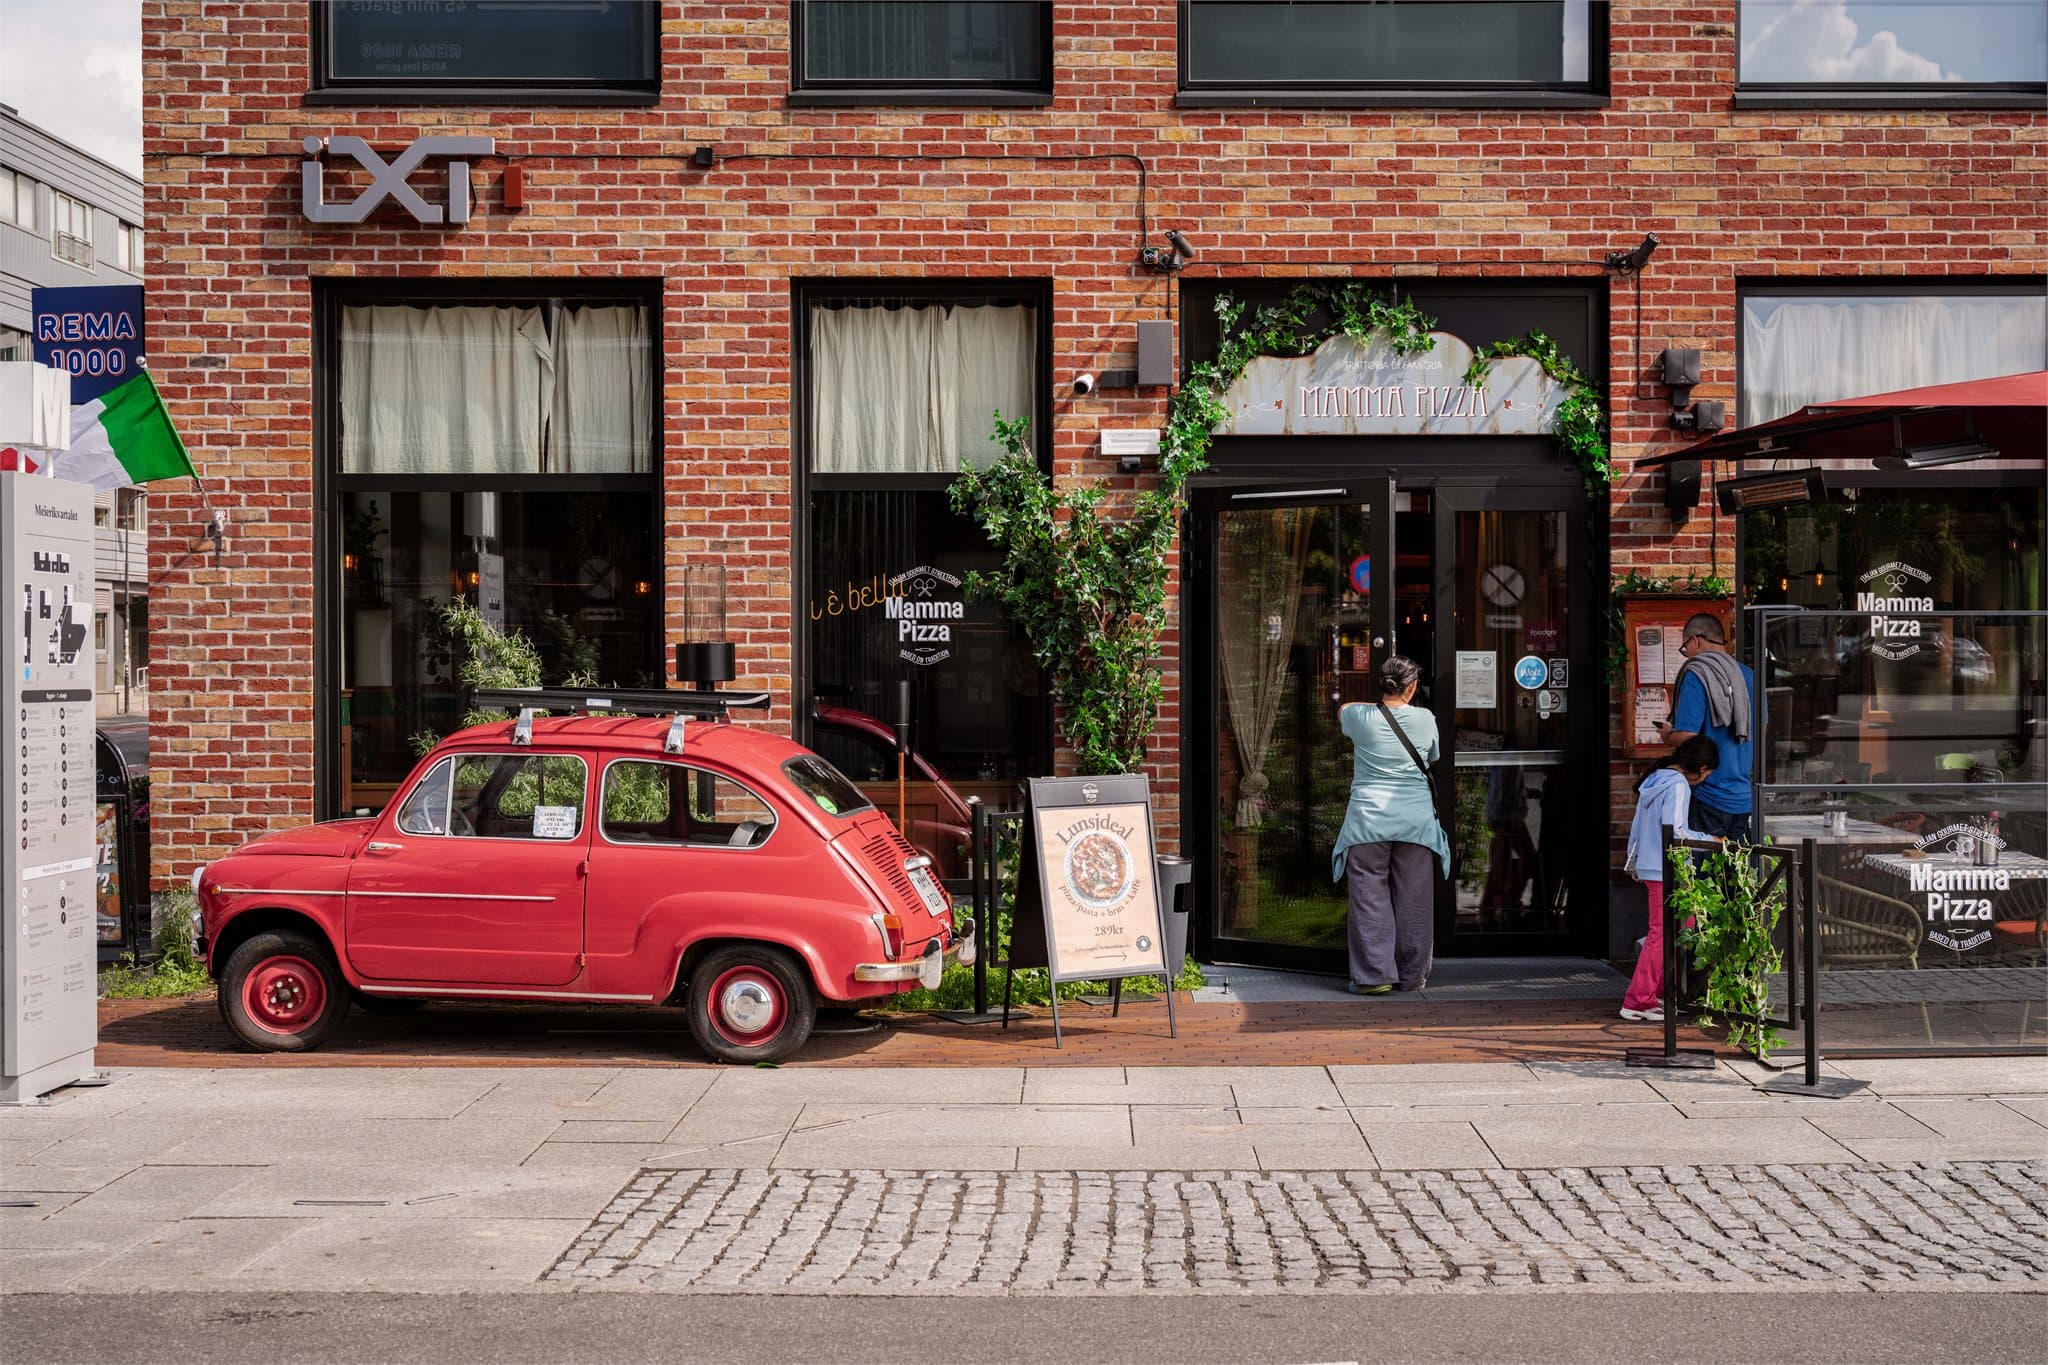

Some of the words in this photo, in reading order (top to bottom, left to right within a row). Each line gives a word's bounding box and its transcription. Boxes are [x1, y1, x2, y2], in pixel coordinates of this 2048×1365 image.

[38, 312, 136, 342] REMA
[51, 348, 126, 376] 1000
[1300, 386, 1405, 417] MAMMA
[1415, 386, 1489, 417] PIZZA
[35, 503, 78, 521] Meierikvartalet
[888, 573, 906, 586] ITALIAN
[906, 566, 931, 578] GOURMET
[931, 567, 962, 587] STREETFOOD
[1860, 568, 1878, 583] ITALIAN
[1878, 562, 1902, 574] GOURMET
[1902, 563, 1932, 583] STREETFOOD
[885, 597, 964, 619] Mamma
[1858, 592, 1934, 612] Mamma
[899, 620, 951, 642] Pizza
[1870, 616, 1921, 637] Pizza
[900, 650, 917, 661] BASED
[925, 650, 950, 663] TRADITION
[1872, 644, 1887, 656] BASED
[1896, 645, 1920, 658] TRADITION
[1520, 667, 1541, 676] Wolt
[1056, 813, 1134, 845] Lunsjdeal
[1913, 833, 1937, 850] ITALIAN
[1938, 824, 1968, 838] GOURMET
[1968, 826, 2007, 849] STREETFOOD
[1910, 863, 2010, 891] Mamma
[1059, 885, 1098, 917] pizza/pasta
[1108, 905, 1125, 917] brus
[1129, 879, 1140, 901] kaffe
[1928, 893, 1992, 921] Pizza
[1094, 925, 1124, 936] 289kr
[1928, 930, 1949, 945] BASED
[1949, 938, 1958, 948] ON
[1961, 930, 1991, 948] TRADITION
